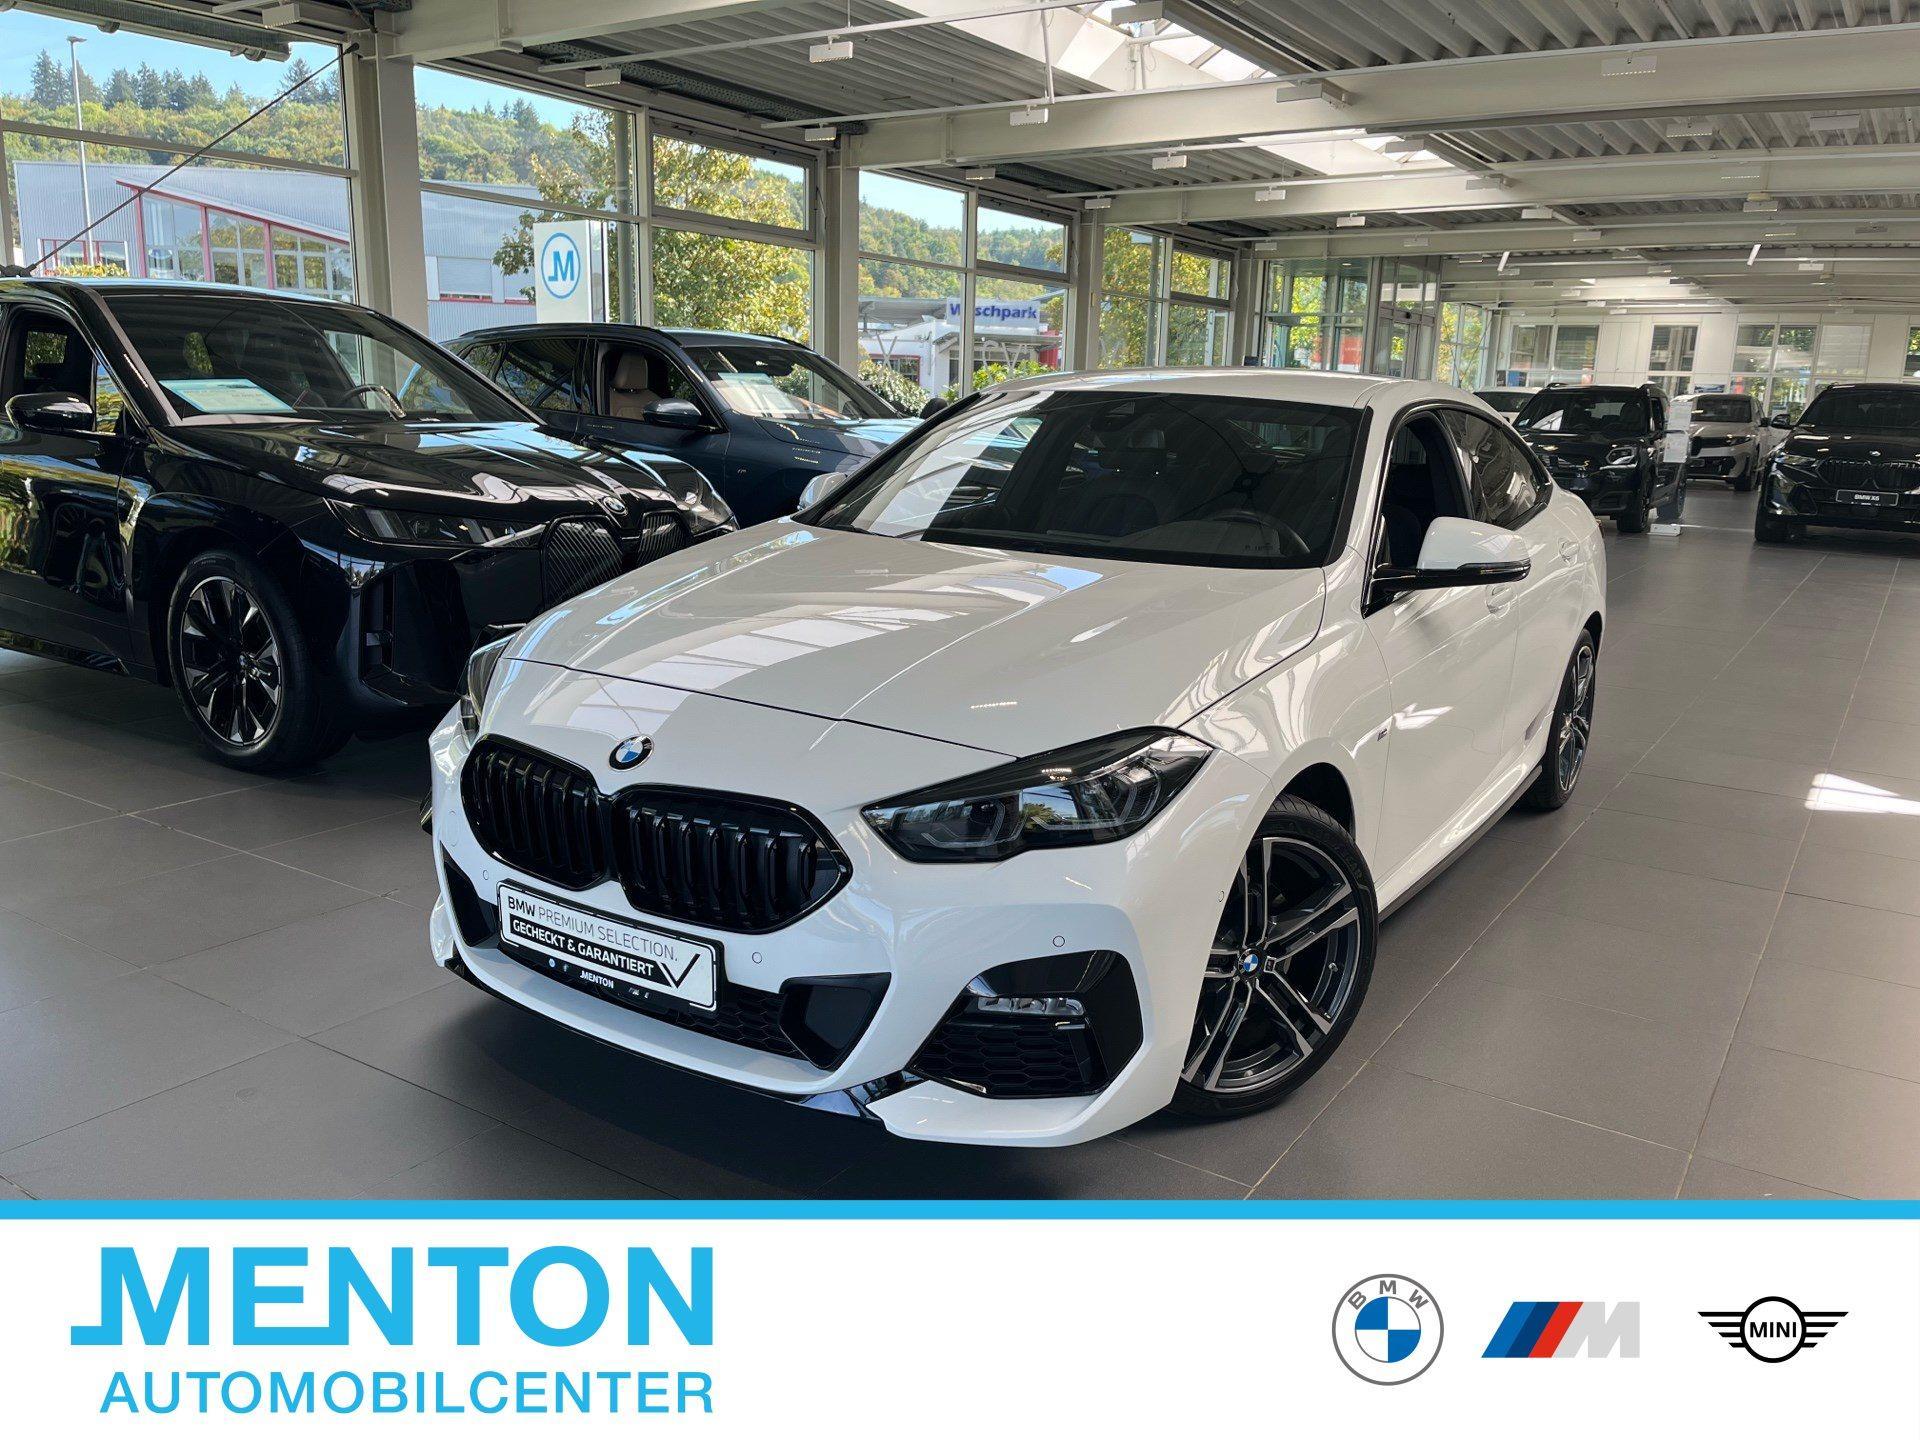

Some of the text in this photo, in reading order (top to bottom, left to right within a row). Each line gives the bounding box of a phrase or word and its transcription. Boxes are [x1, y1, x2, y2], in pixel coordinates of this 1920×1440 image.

[949, 303, 1037, 321] Wschpark
[508, 896, 678, 962] BMW PREMIUM SELECTION.
[513, 919, 654, 977] GECHECKT & GARANTIERT
[580, 970, 615, 989] MENTON
